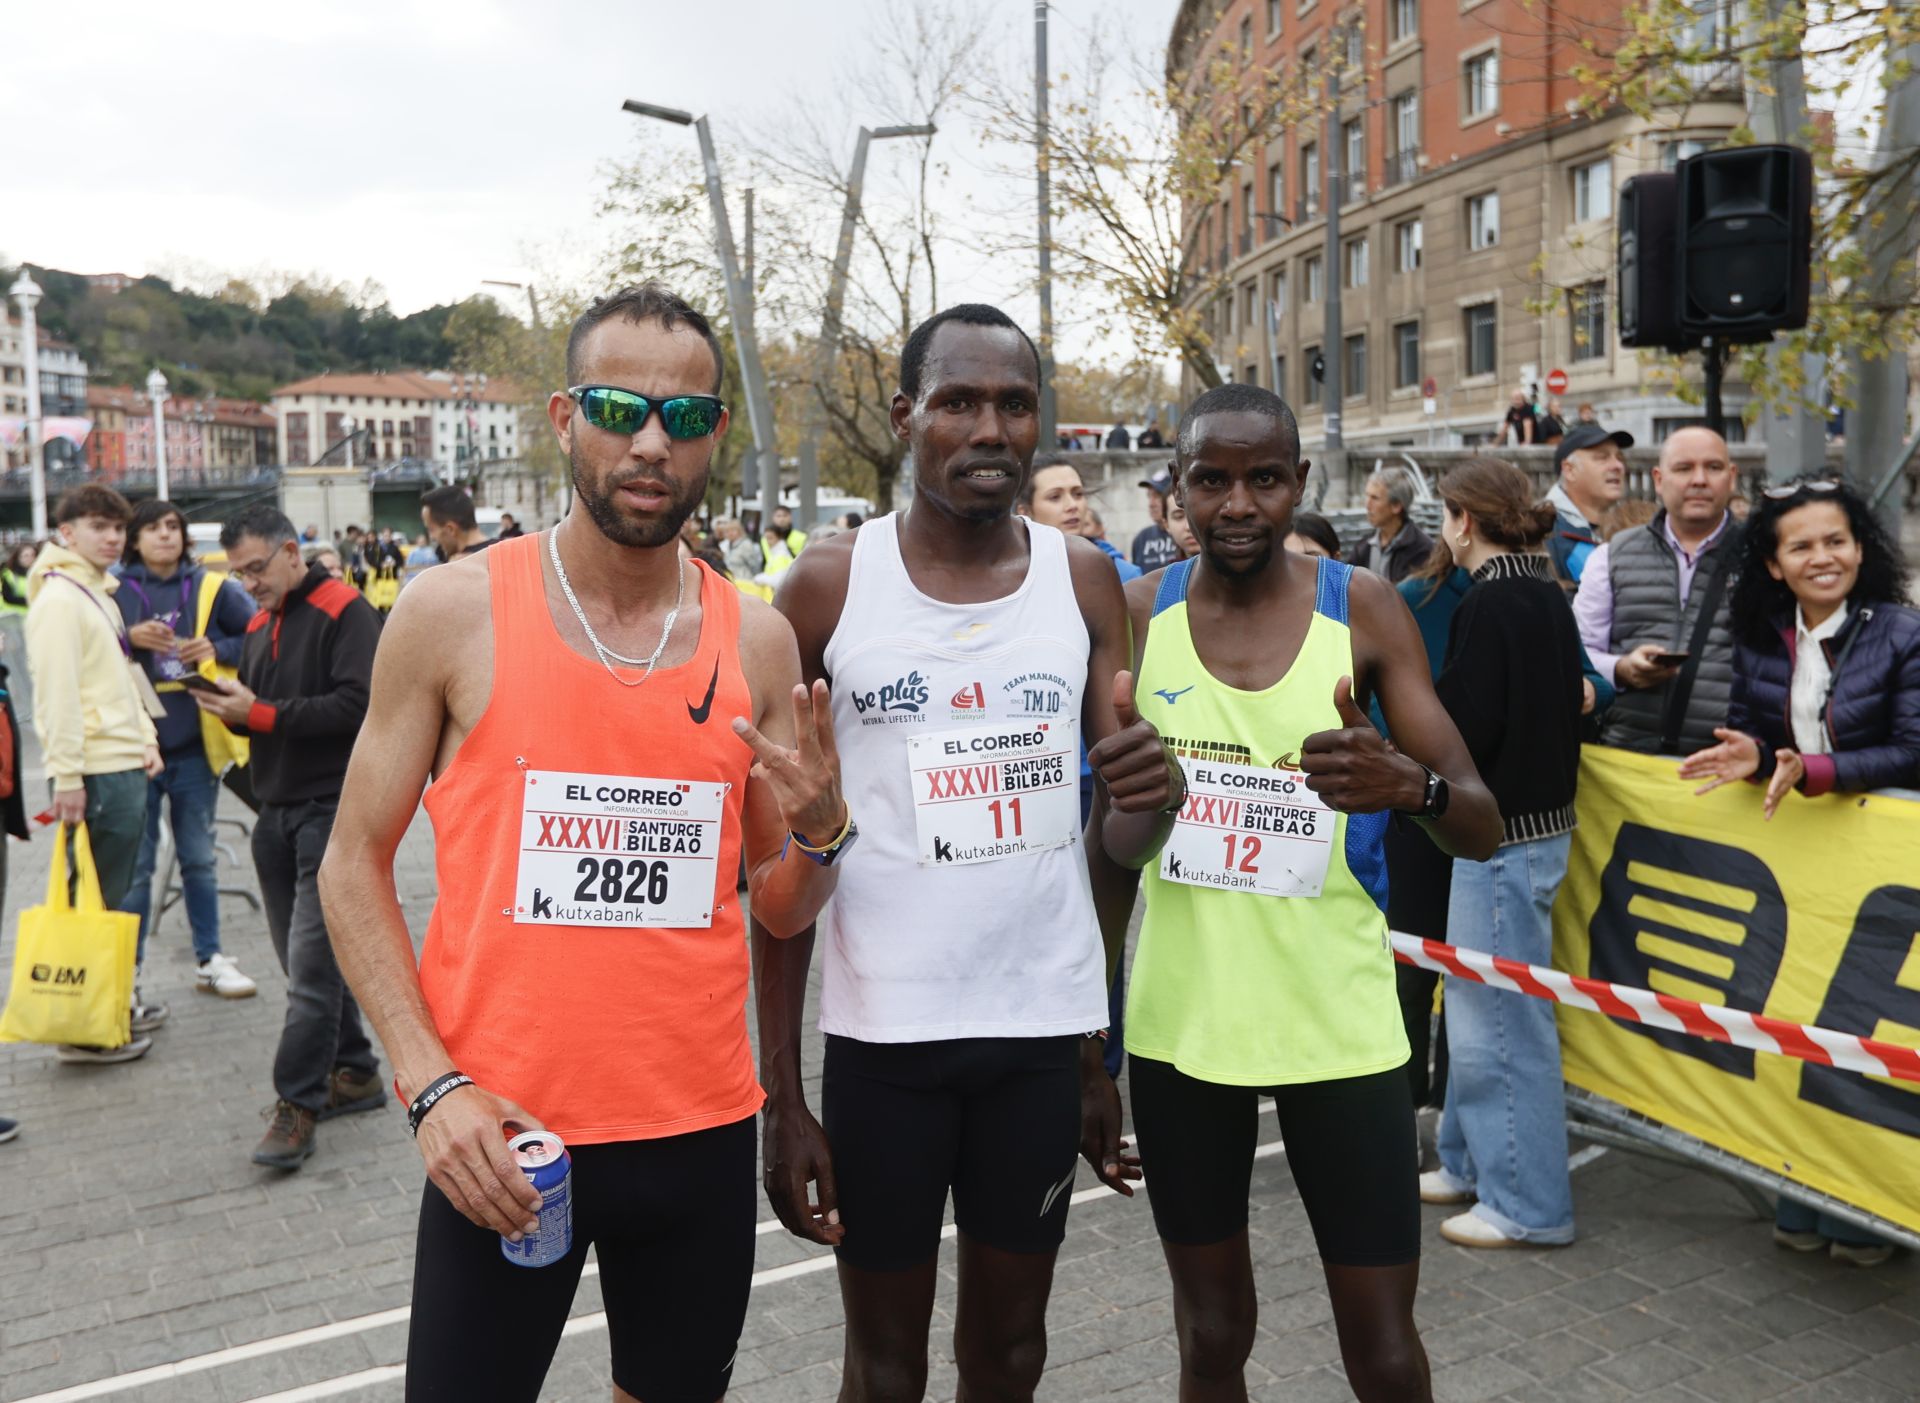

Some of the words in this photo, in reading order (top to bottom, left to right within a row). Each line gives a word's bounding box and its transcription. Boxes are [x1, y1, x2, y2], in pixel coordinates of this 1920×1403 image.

[1002, 674, 1027, 692] TEAM
[1029, 672, 1066, 688] MANAGER
[852, 690, 876, 714] be
[878, 678, 929, 712] plus
[1023, 690, 1044, 712] TM
[1046, 690, 1060, 713] 10
[862, 716, 886, 726] NATURAL
[888, 714, 926, 724] LIFESTYLE
[951, 713, 986, 721] calatayud
[943, 740, 968, 755] EL
[970, 731, 1044, 752] CORREO
[1003, 756, 1063, 776] SANTURCE
[926, 764, 999, 800] XXXVI
[1195, 769, 1217, 785] EL
[1220, 772, 1296, 794] CORREO
[566, 784, 592, 802] EL
[596, 786, 682, 806] CORREO
[654, 808, 668, 816] CON
[987, 797, 1022, 840] 11
[1246, 802, 1317, 823] SANTURCE
[536, 815, 621, 850] XXXVI
[628, 820, 702, 837] SANTURCE
[956, 838, 1028, 860] kutxabank
[1223, 833, 1262, 874] 12
[573, 857, 669, 905] 2826
[1183, 869, 1257, 889] kutxabank
[556, 904, 644, 922] kutxabank
[436, 1077, 460, 1096] HEART
